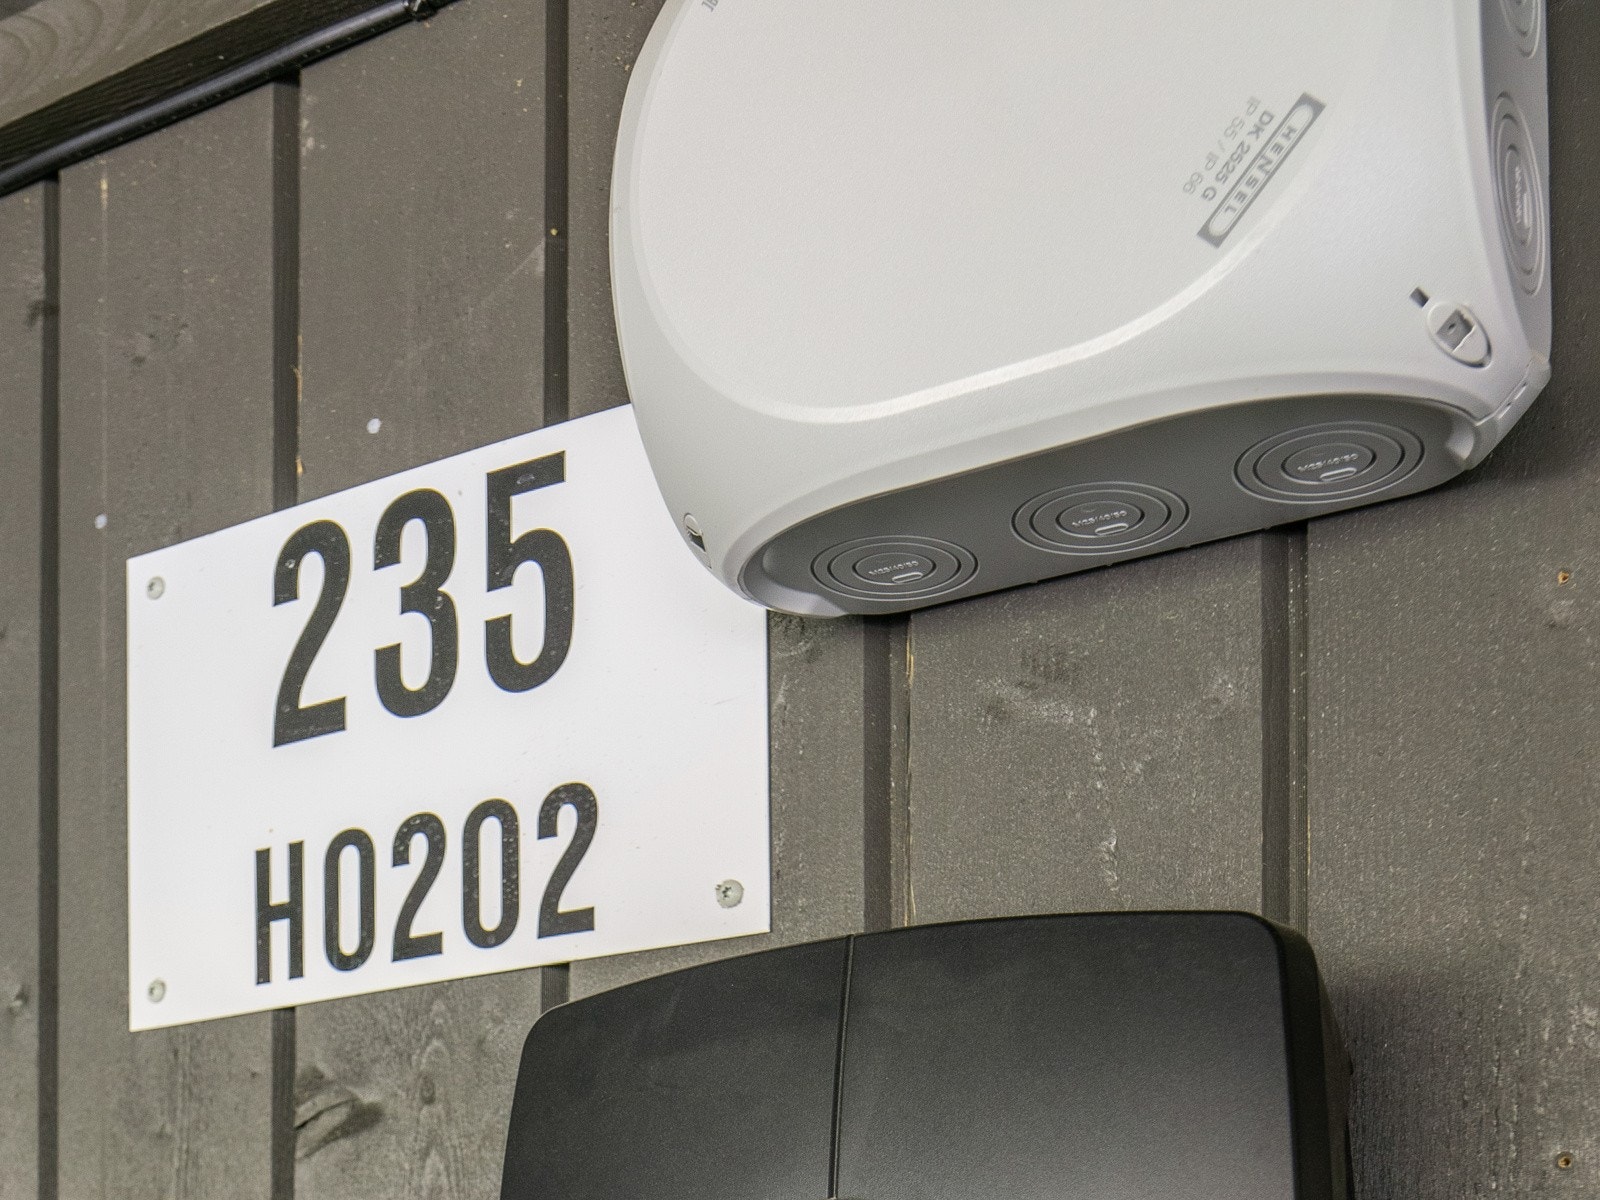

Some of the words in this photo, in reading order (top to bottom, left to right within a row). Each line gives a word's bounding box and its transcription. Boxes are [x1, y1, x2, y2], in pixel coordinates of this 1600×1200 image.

[1247, 110, 1275, 140] DK
[1215, 140, 1251, 185] 2525
[1224, 125, 1298, 214] HENSEL
[1201, 186, 1217, 201] G
[272, 450, 575, 748] 235
